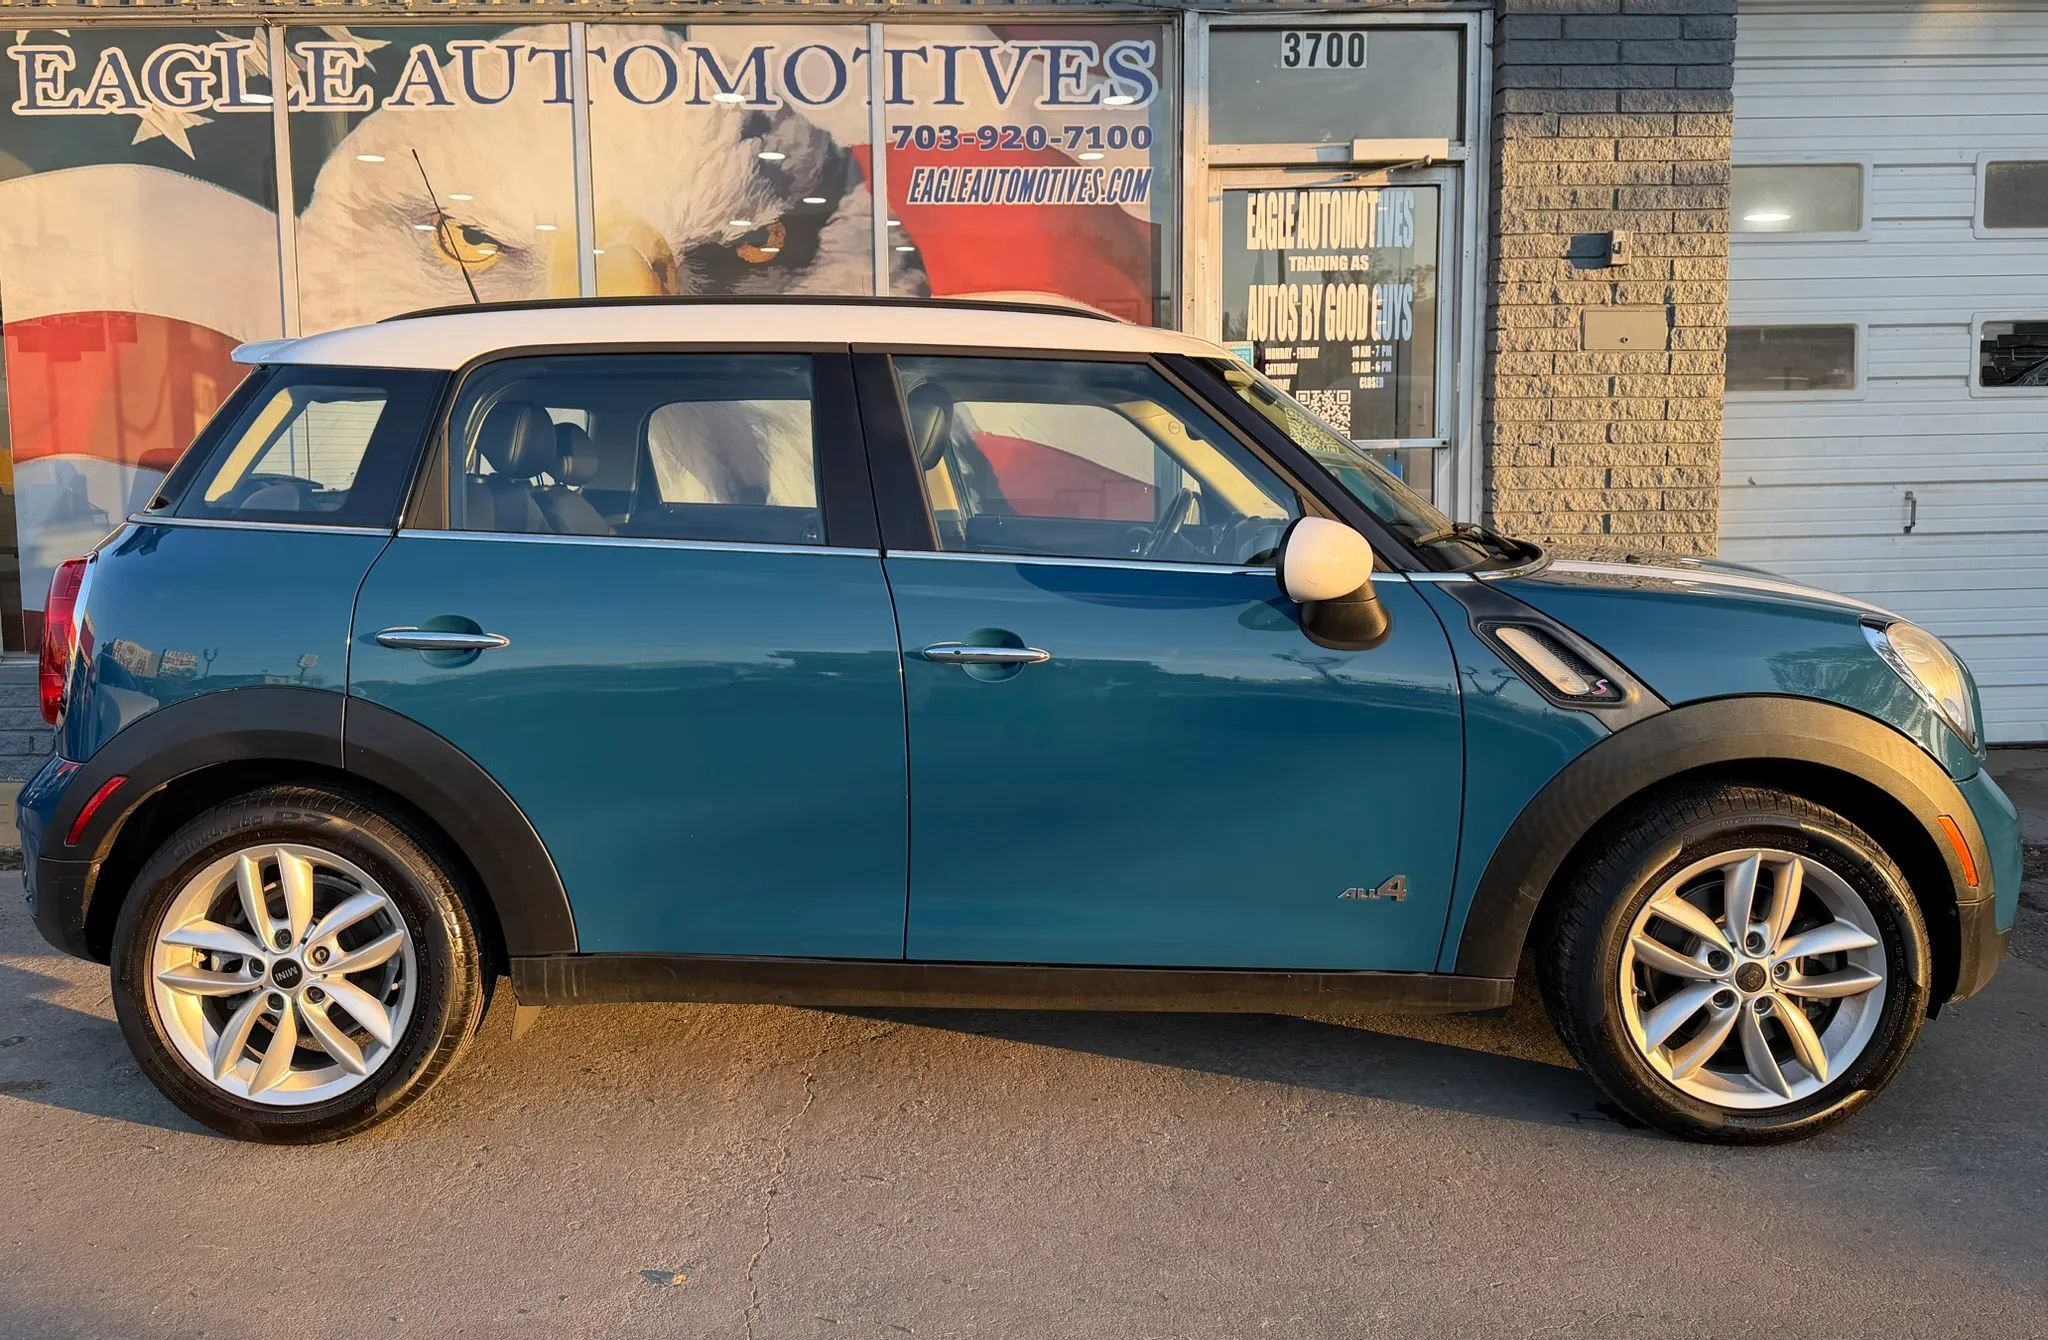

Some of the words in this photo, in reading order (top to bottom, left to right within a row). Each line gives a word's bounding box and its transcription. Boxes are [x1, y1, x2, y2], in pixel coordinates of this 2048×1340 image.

[1283, 32, 1365, 68] 3700
[9, 43, 375, 114] EAGLE
[382, 38, 1159, 112] AUTOMOTIVES
[892, 124, 1154, 151] 703-920-7100
[907, 166, 1155, 204] EAGLEAUTOMOTIVES.COM
[1247, 191, 1296, 250] EAGLE
[1297, 190, 1415, 250] AUTOMOTIVES
[1289, 255, 1349, 272] TRADING
[1350, 254, 1370, 271] AS
[1247, 283, 1299, 342] AUTOS
[1301, 283, 1323, 341] BY
[1325, 283, 1369, 341] GOOD
[1370, 283, 1413, 341] GUYS
[1296, 346, 1320, 359] FRIDAY
[1381, 344, 1392, 357] PM
[1264, 362, 1298, 376] SATURDAY
[1381, 360, 1391, 373] PM
[1359, 376, 1384, 389] CLOSED
[275, 965, 299, 982] MINI
